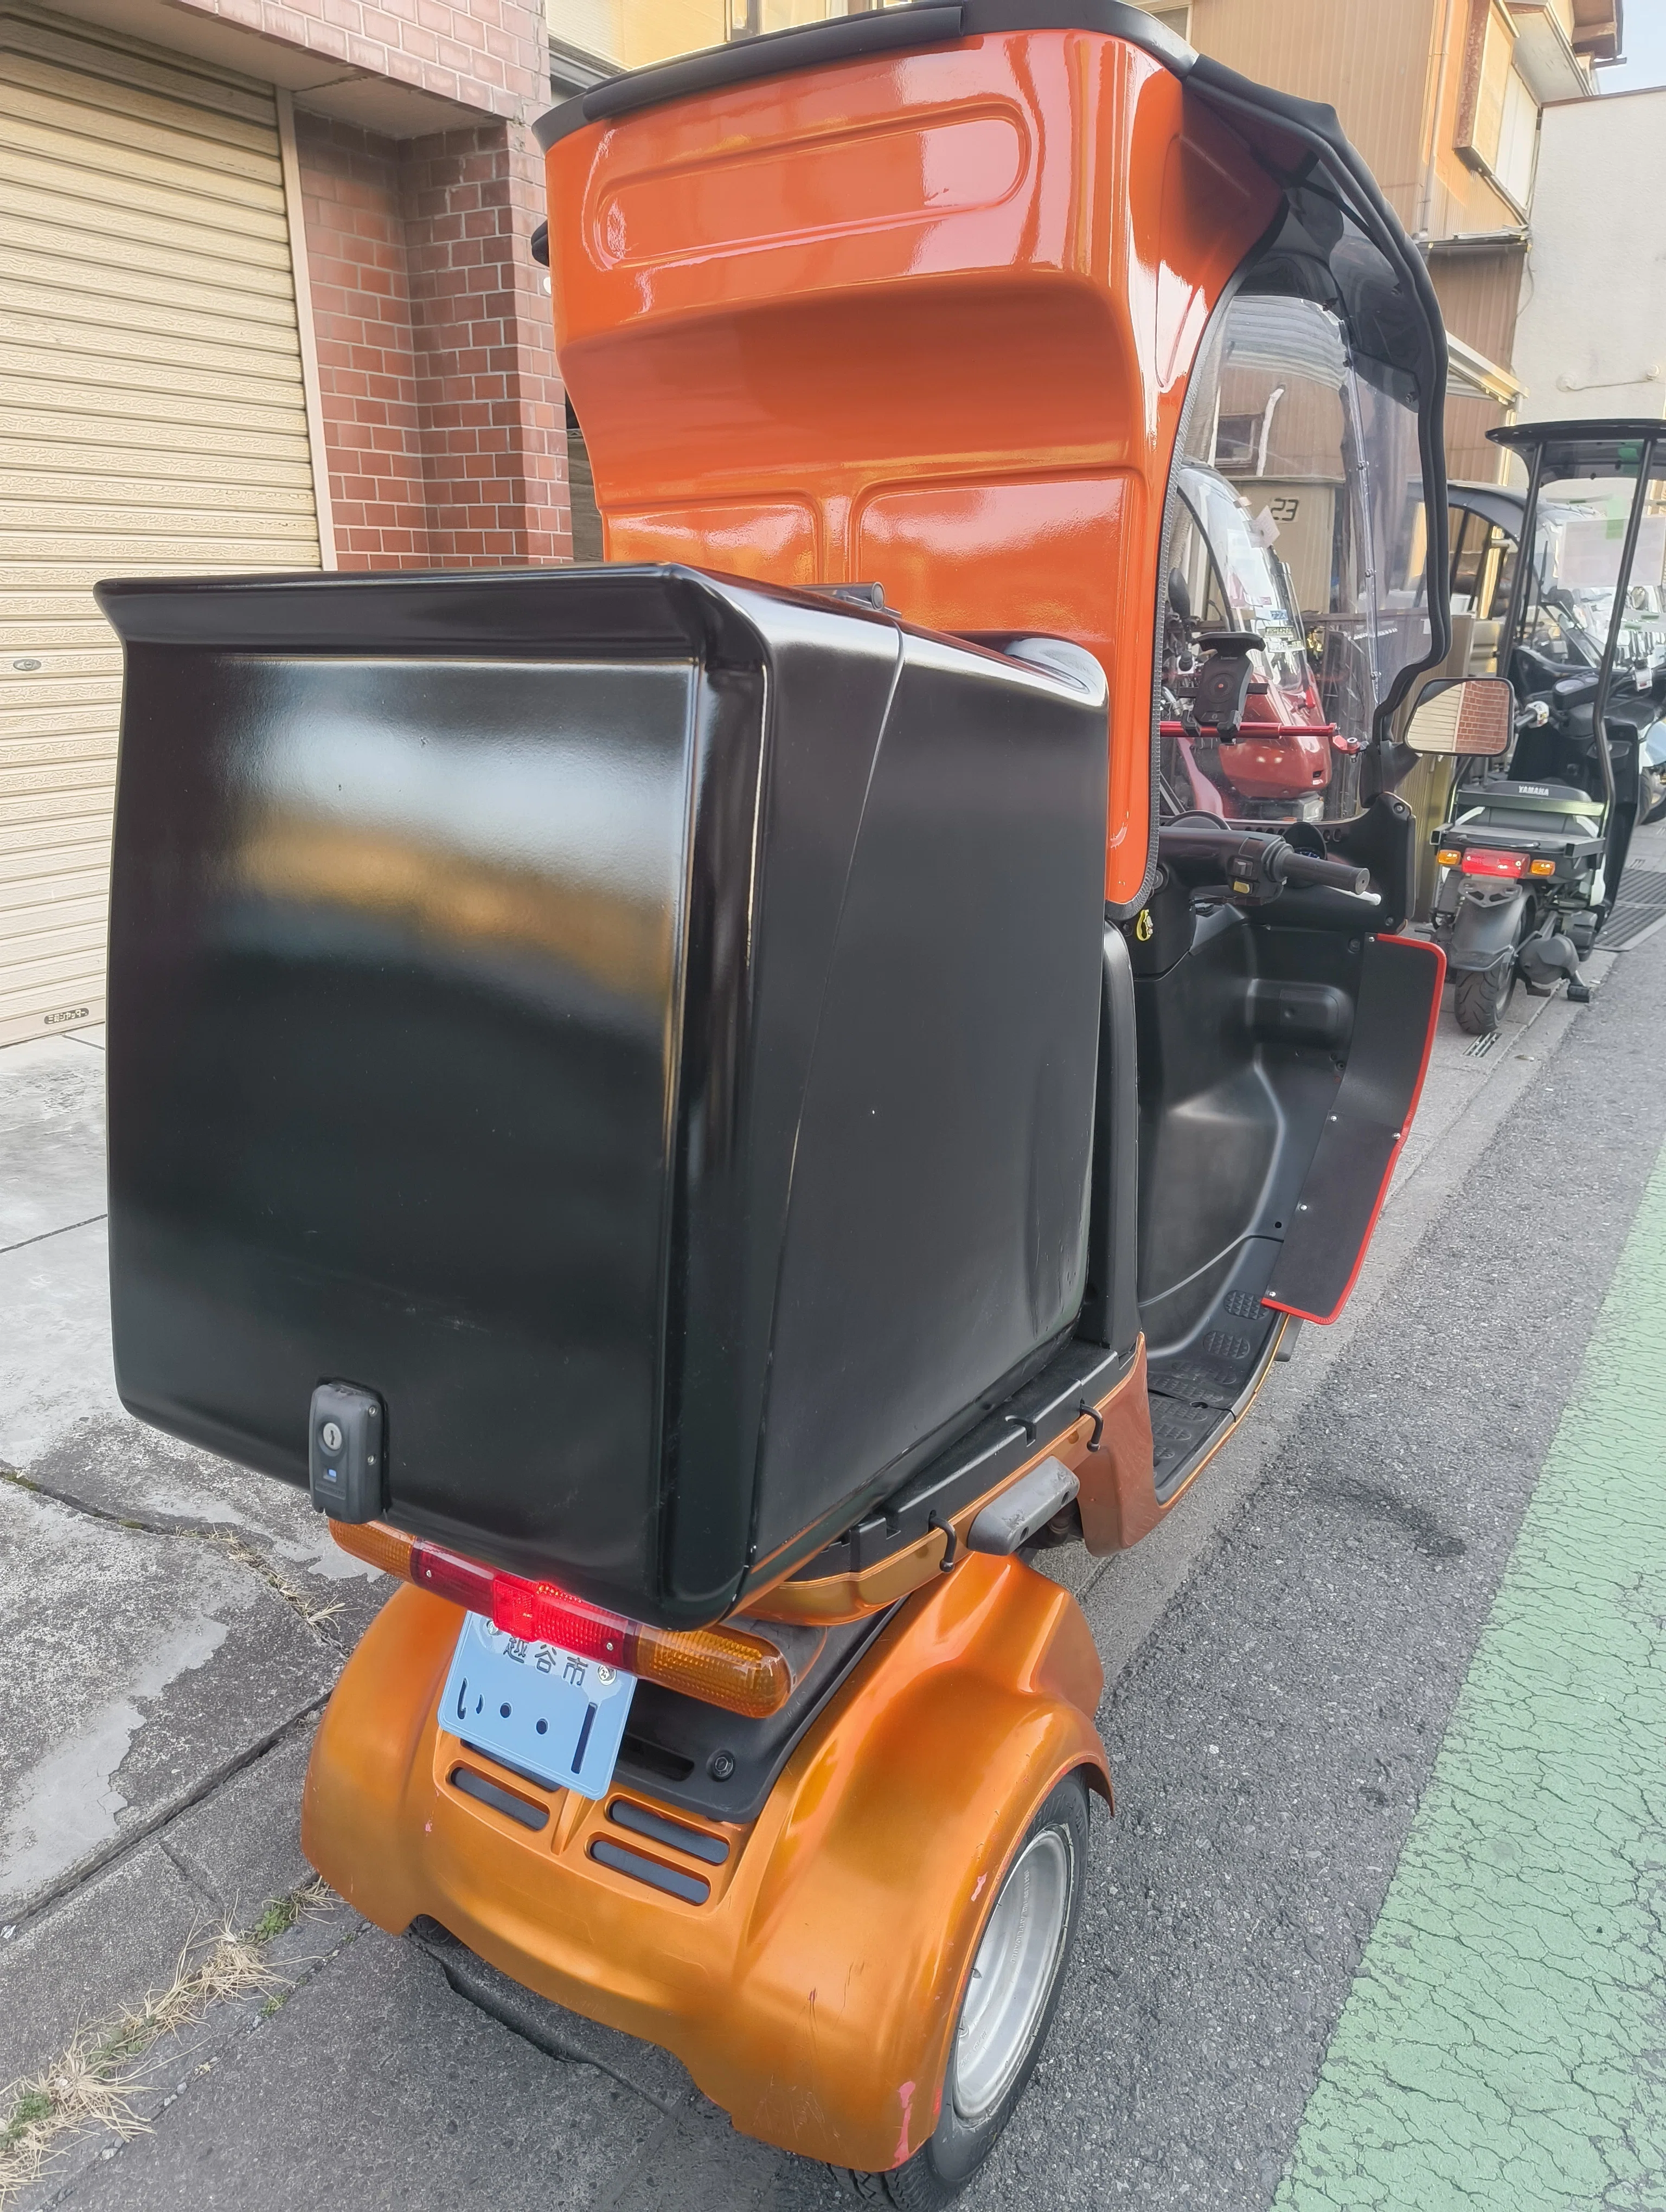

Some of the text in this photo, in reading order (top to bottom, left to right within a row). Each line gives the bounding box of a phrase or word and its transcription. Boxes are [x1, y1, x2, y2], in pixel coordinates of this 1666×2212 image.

[1271, 498, 1299, 522] 23
[1518, 785, 1549, 796] YAMAHA
[503, 1636, 589, 1687] 越谷市
